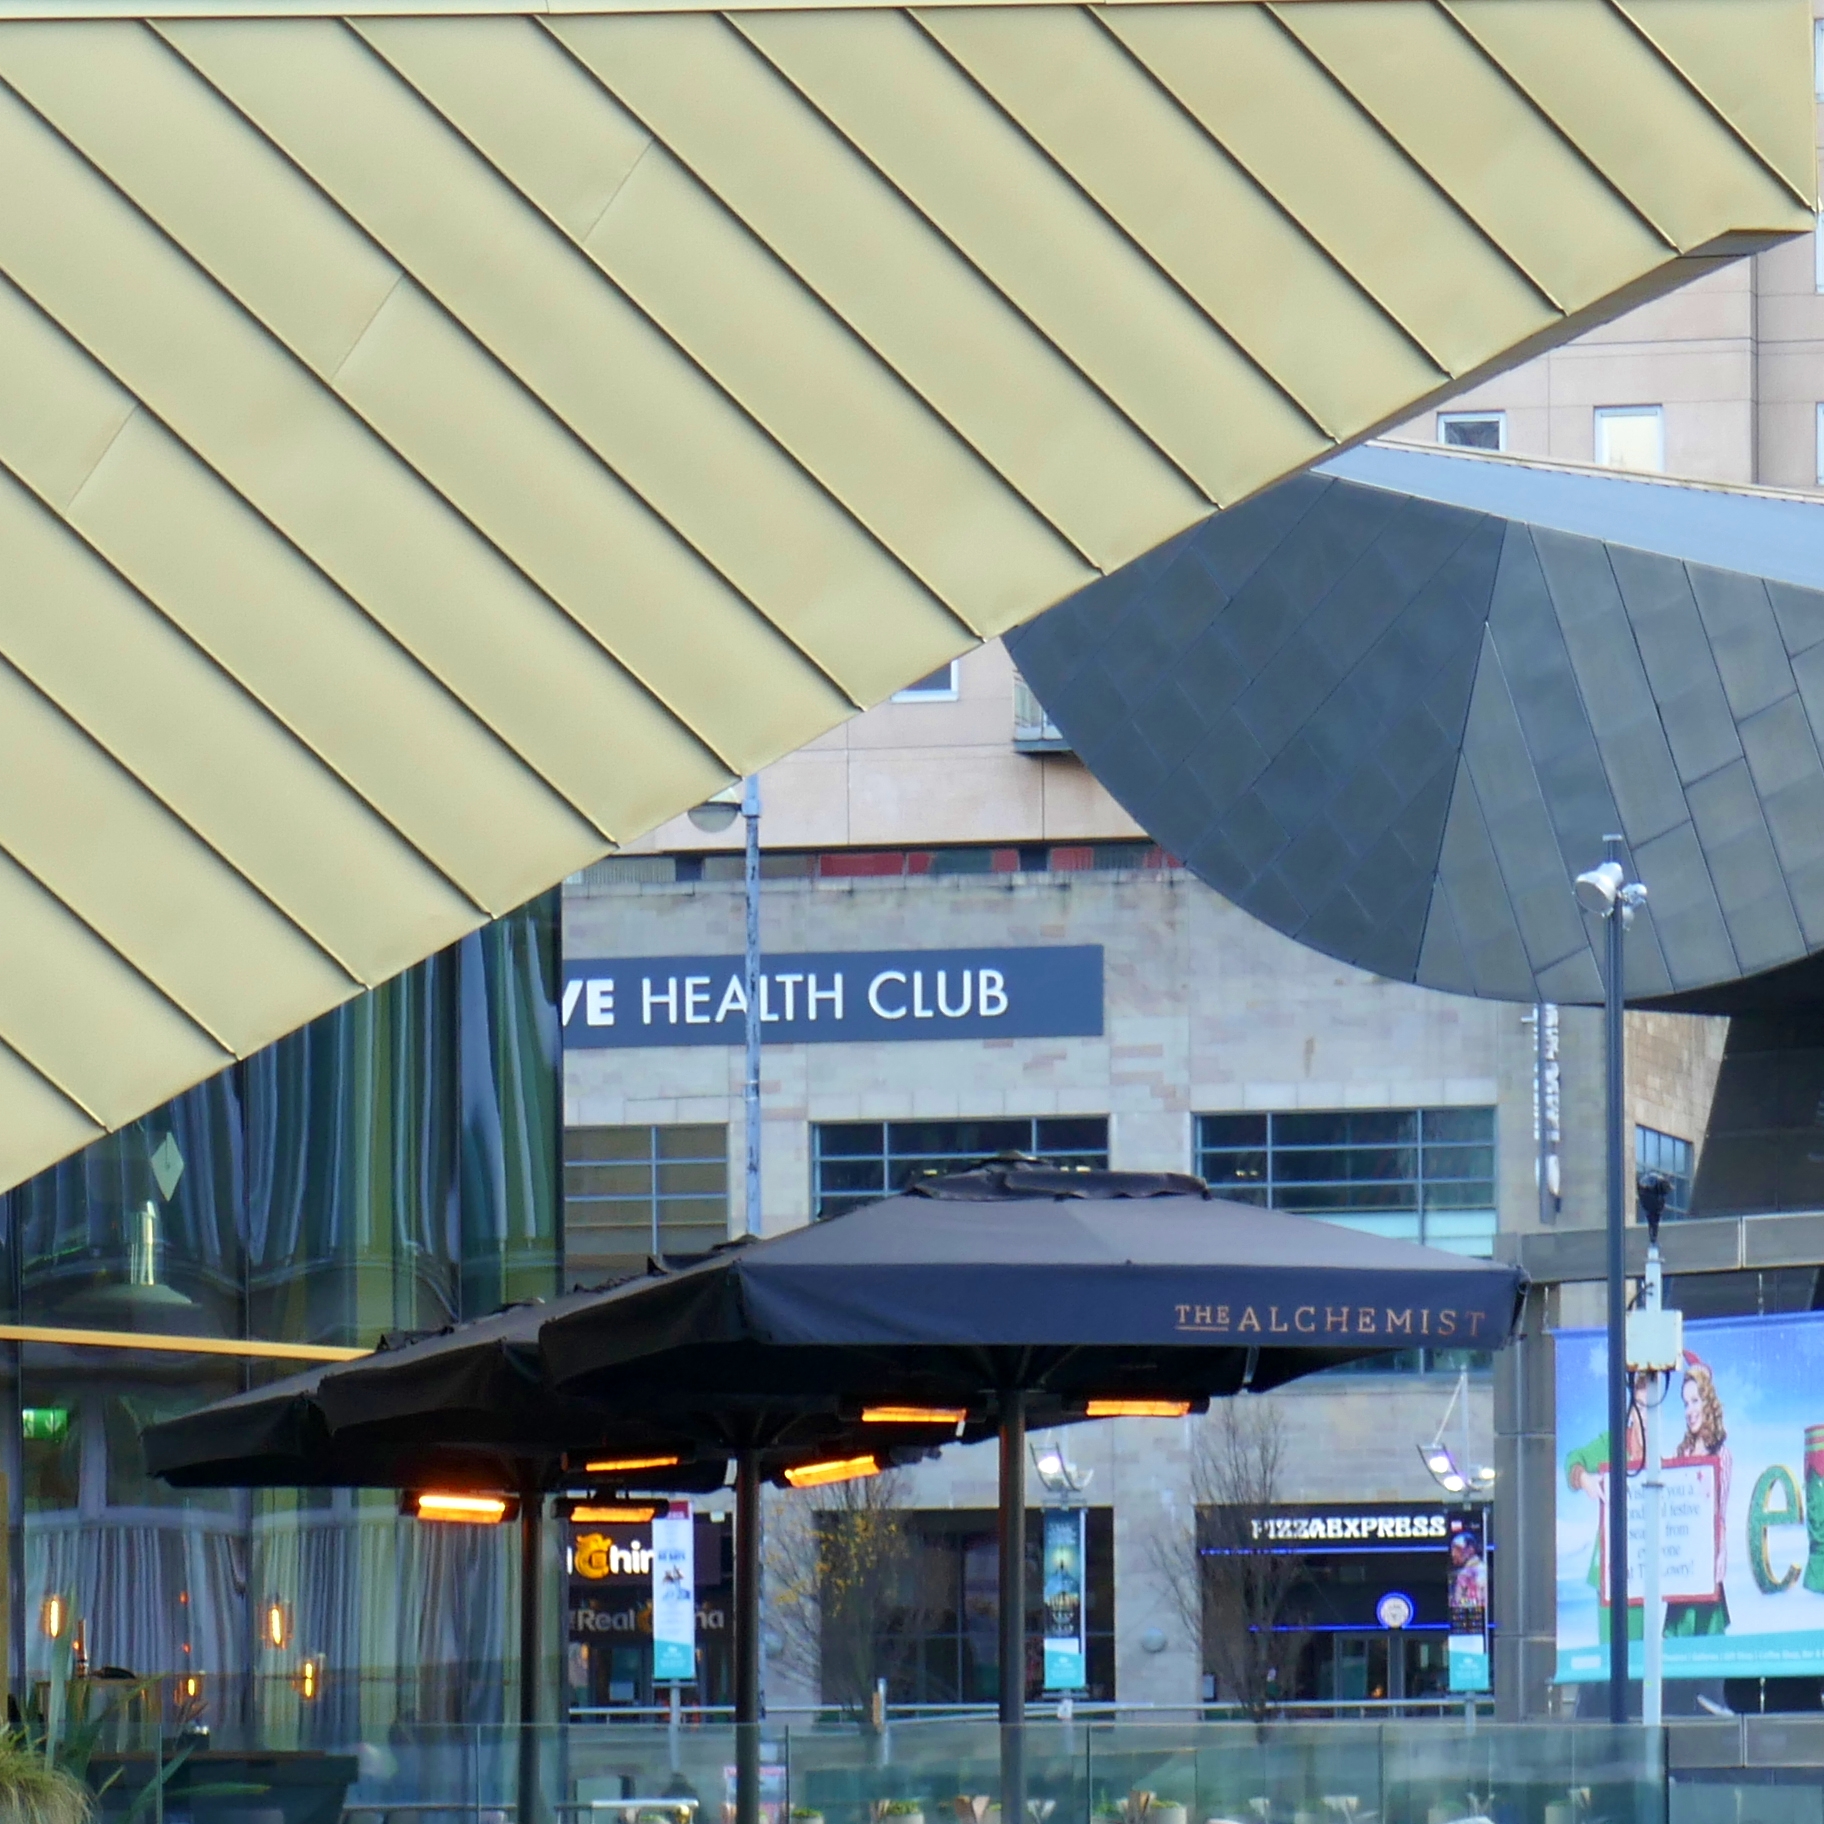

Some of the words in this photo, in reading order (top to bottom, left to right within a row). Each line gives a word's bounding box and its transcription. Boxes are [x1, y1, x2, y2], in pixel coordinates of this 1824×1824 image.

[641, 972, 844, 1025] HEALTH
[867, 968, 1010, 1020] CLUB
[1174, 1304, 1231, 1324] THE
[1237, 1306, 1486, 1337] ALCHEMIST
[1251, 1515, 1446, 1540] PIZZAEXPRESS
[577, 1607, 635, 1632] Real
